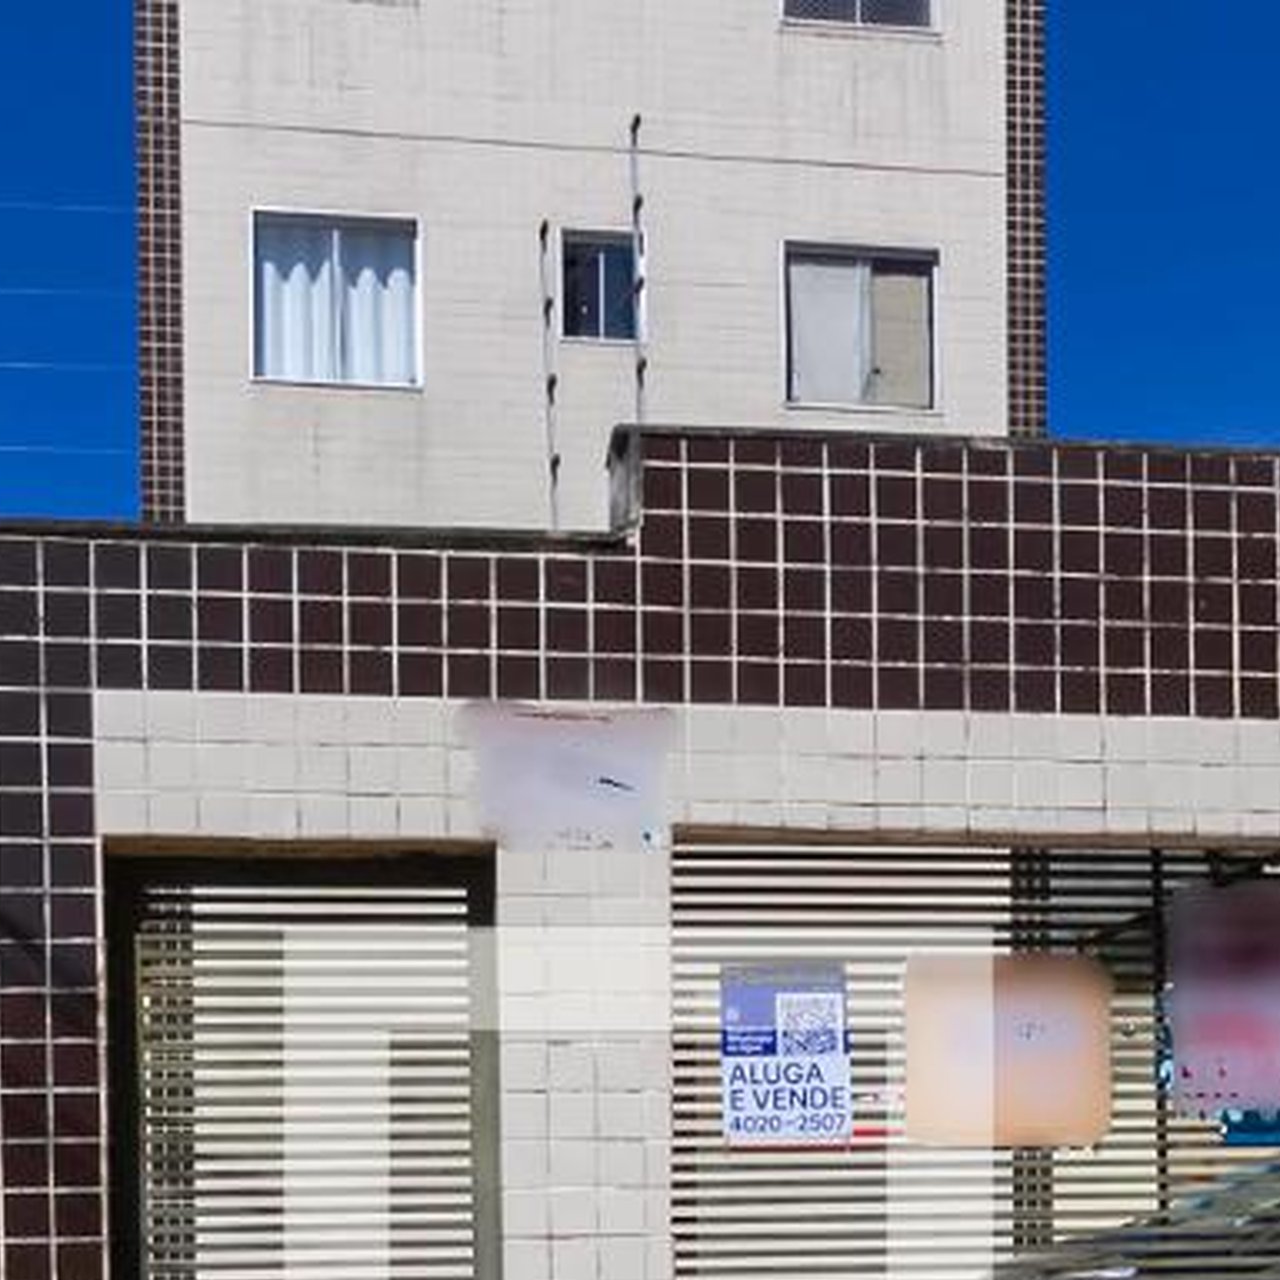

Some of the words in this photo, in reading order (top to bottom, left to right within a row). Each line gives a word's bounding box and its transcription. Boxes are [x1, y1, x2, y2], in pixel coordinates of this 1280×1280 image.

[729, 1063, 824, 1086] ALUGA
[730, 1088, 745, 1111] E
[753, 1086, 846, 1110] VENDE
